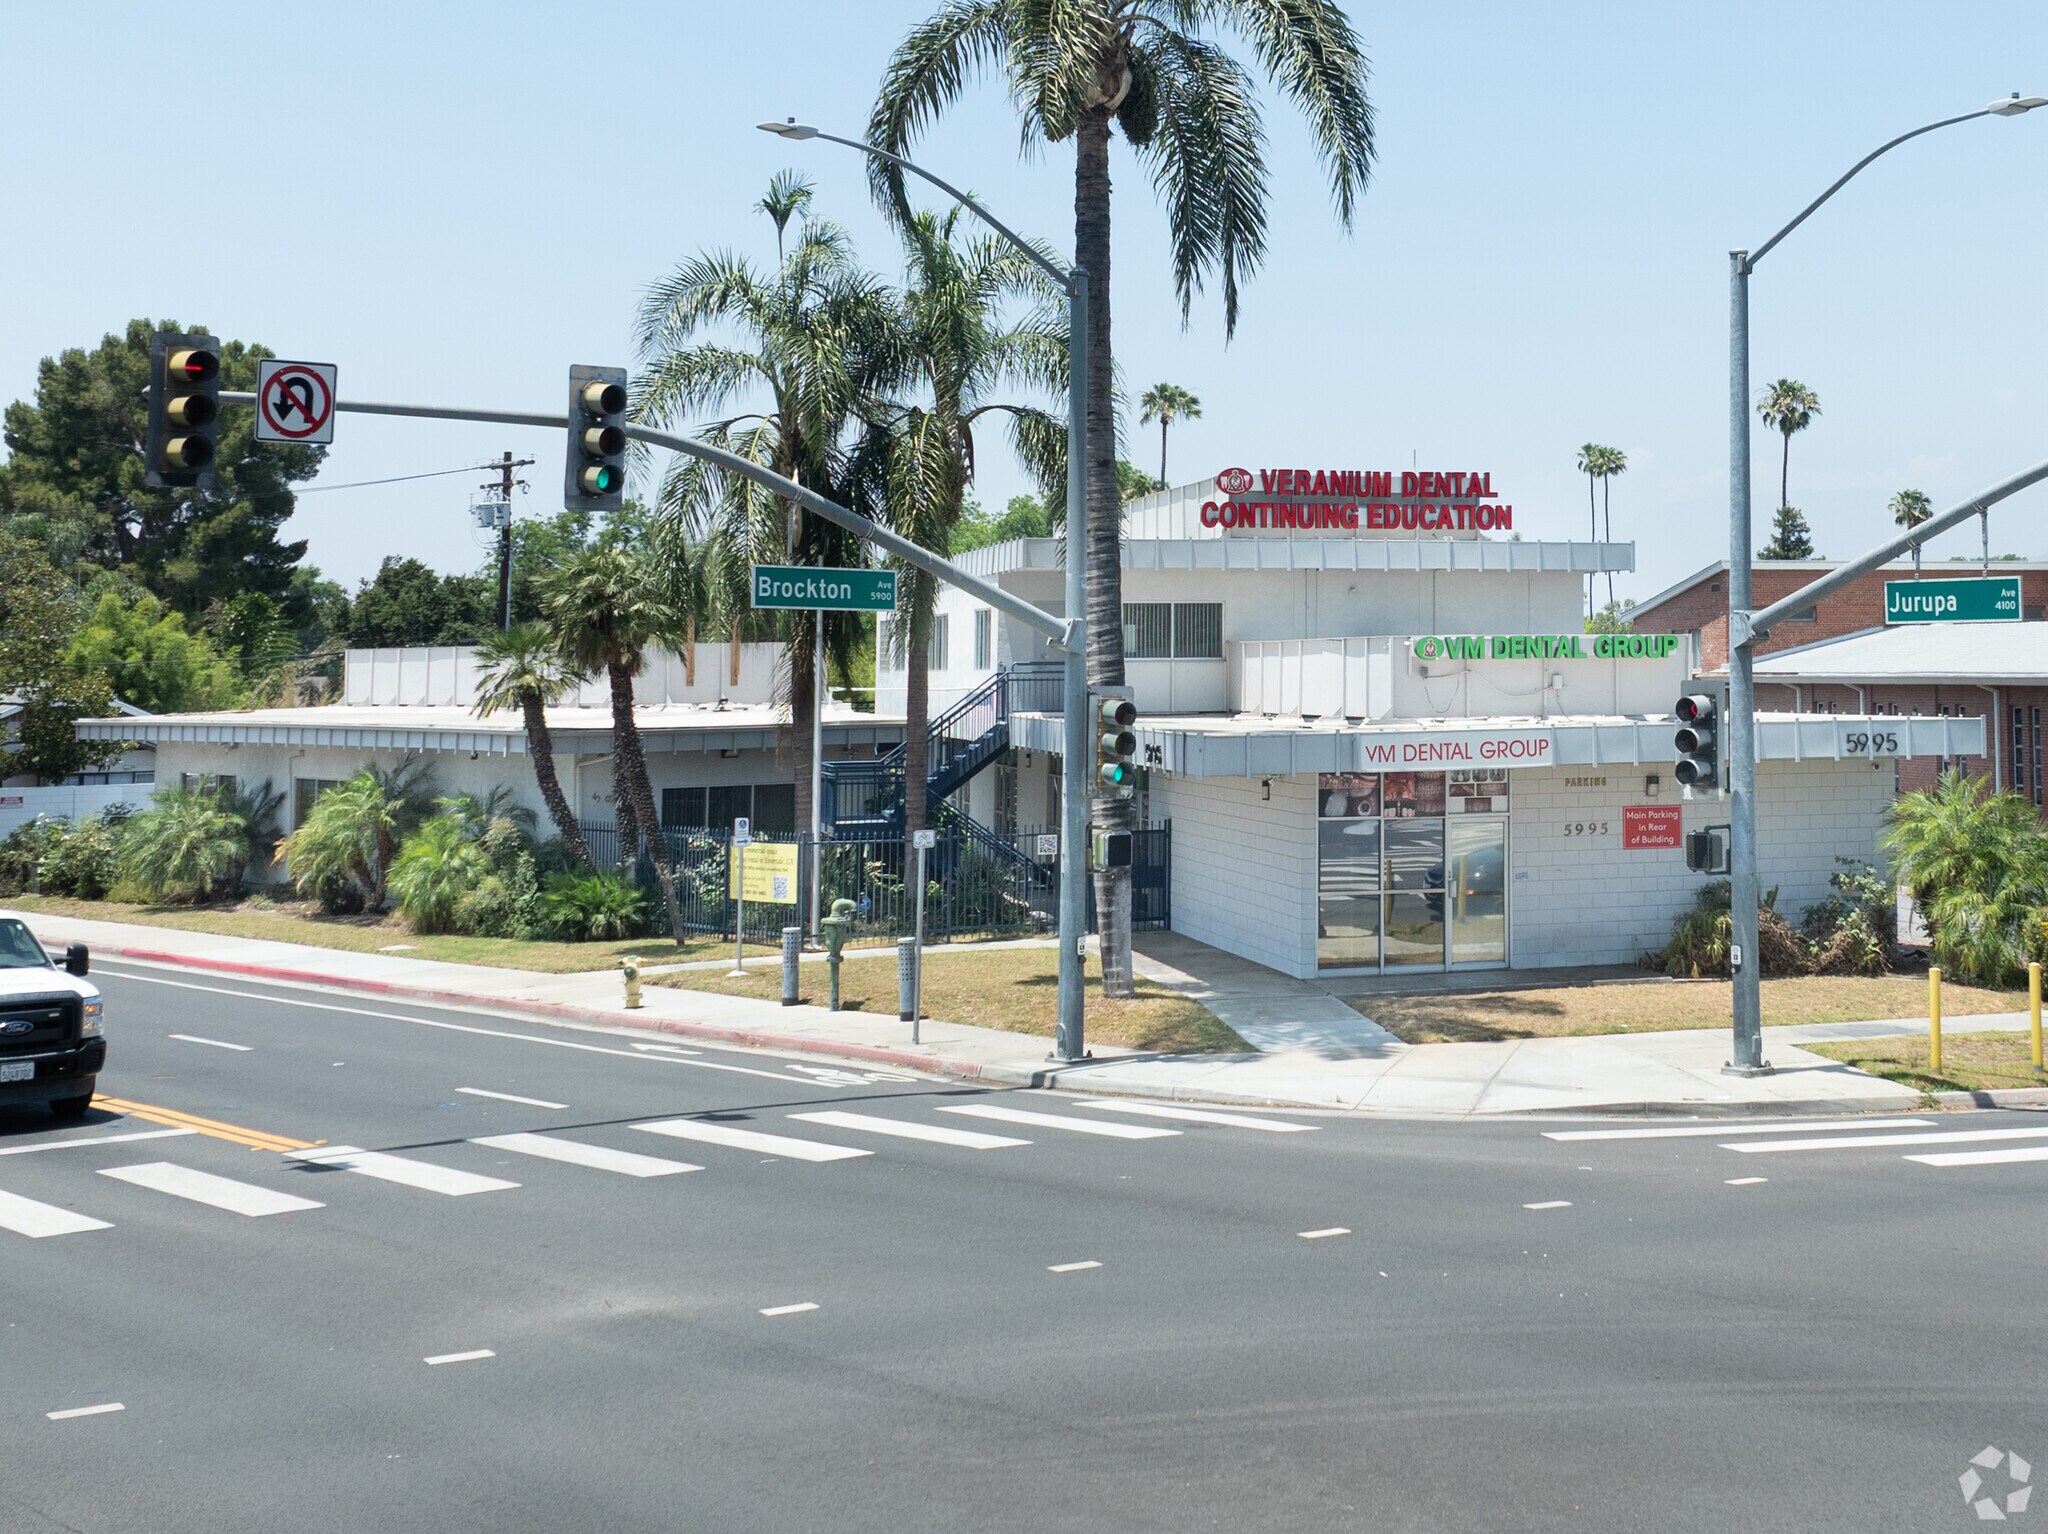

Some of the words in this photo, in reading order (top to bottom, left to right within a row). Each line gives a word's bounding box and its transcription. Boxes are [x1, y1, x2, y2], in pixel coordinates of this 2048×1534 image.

[1260, 469, 1392, 498] VERANIUM
[1401, 472, 1498, 498] DENTAL
[1201, 501, 1359, 530] CONTINUING
[1366, 503, 1512, 531] EDUCATION
[758, 576, 851, 600] Brockton
[877, 580, 892, 590] Ave
[870, 592, 892, 601] 5900
[2000, 588, 2016, 598] Ave
[1889, 592, 1958, 617] Jurupa
[1994, 600, 2016, 610] 4100
[1444, 636, 1486, 660] VM
[1491, 635, 1588, 660] DENTAL
[1594, 635, 1679, 659] GROUP
[1846, 732, 1898, 753] 5995
[1365, 745, 1396, 763] VM
[1403, 742, 1473, 762] DENTAL
[1480, 739, 1549, 760] GROUP
[1565, 777, 1607, 787] PARKING
[1626, 812, 1647, 820] Main
[1648, 811, 1679, 820] Parking
[1563, 822, 1609, 837] 5995
[1638, 823, 1647, 831] in
[1648, 823, 1668, 831] Rear
[1631, 836, 1641, 844] of
[1641, 835, 1675, 845] Building
